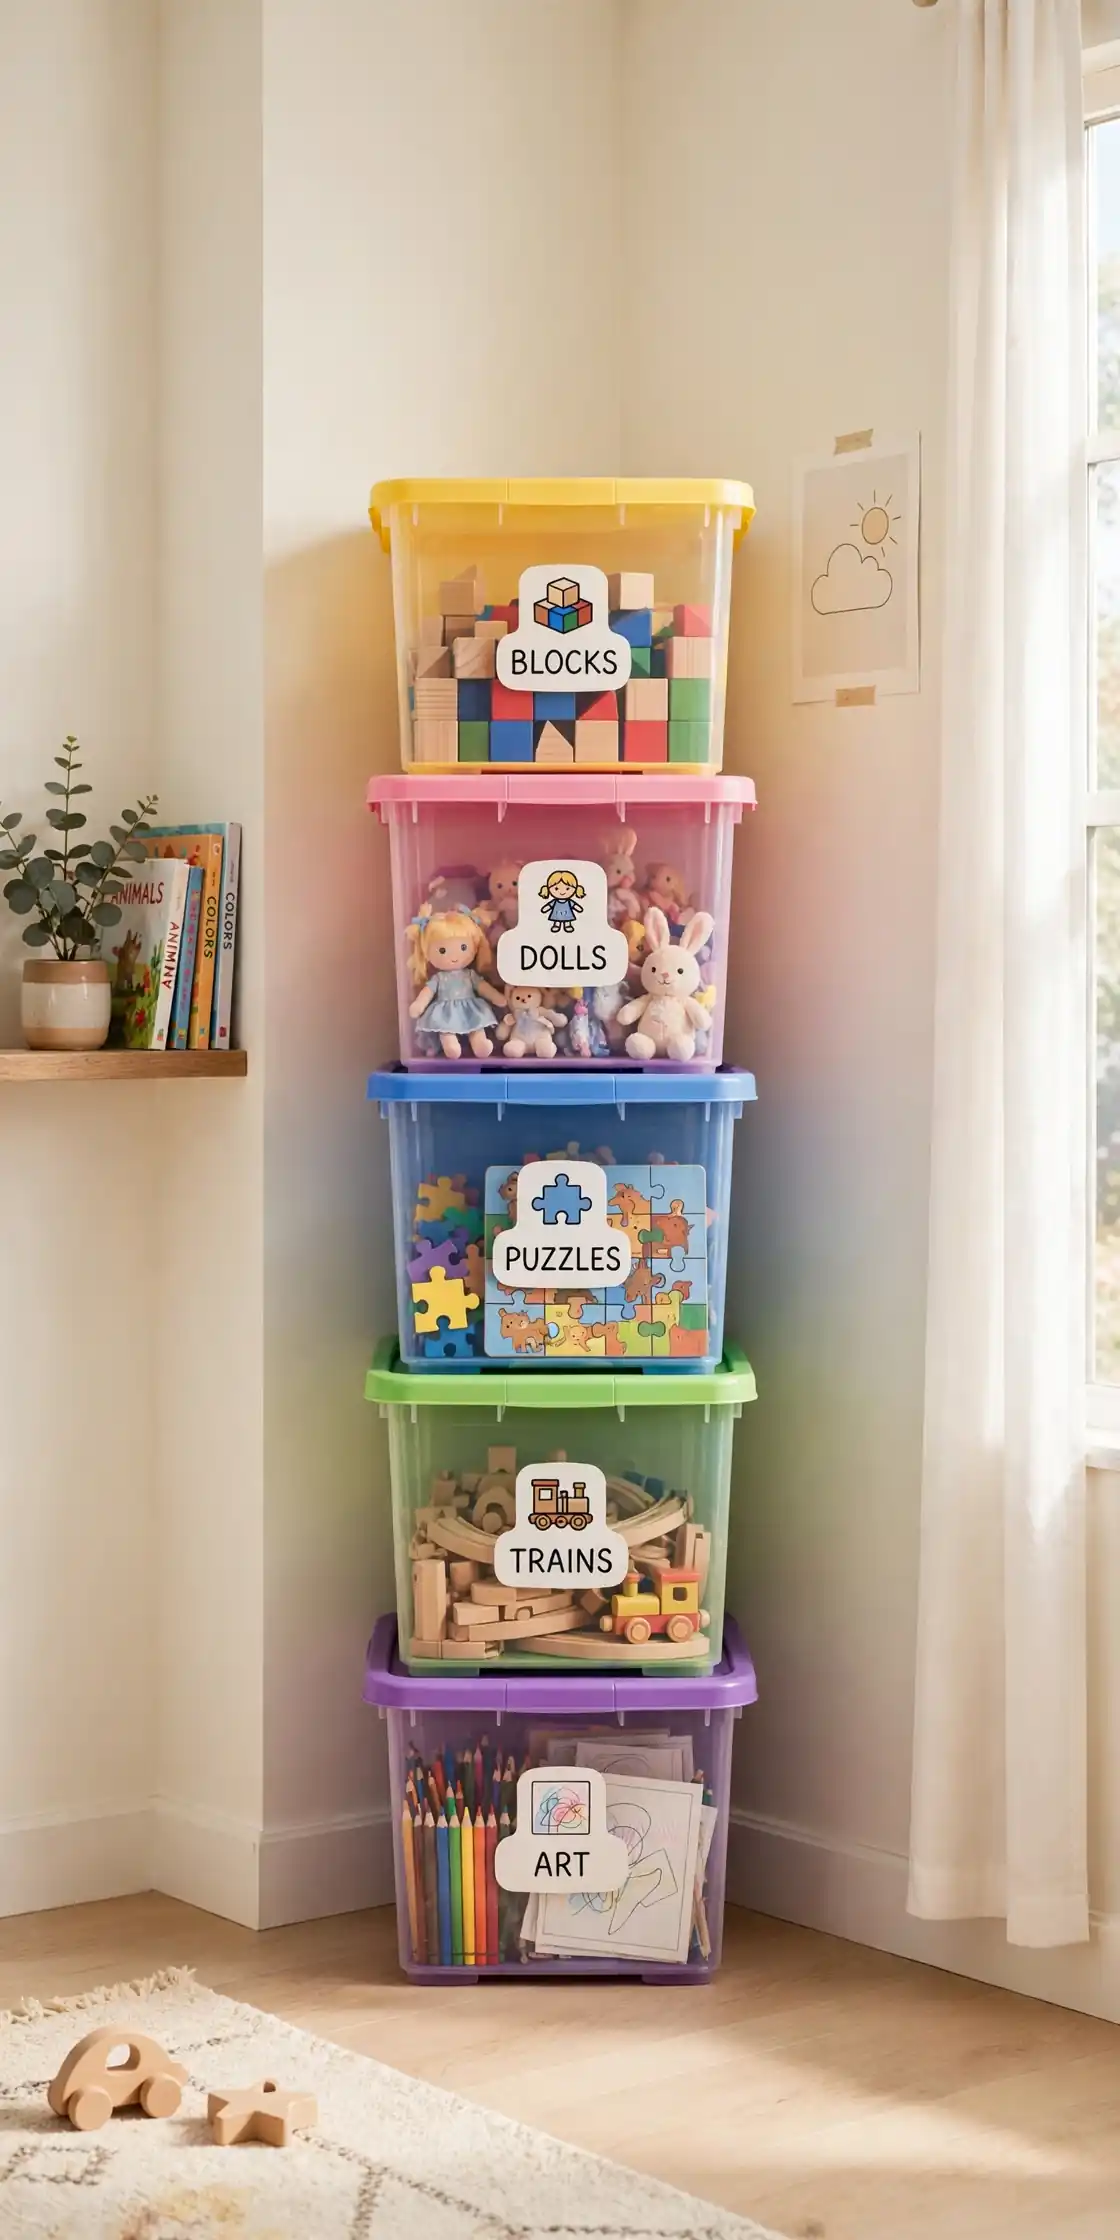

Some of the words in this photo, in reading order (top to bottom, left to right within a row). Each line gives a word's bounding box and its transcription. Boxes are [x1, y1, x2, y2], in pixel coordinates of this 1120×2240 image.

[511, 649, 618, 675] BLOCKS
[203, 896, 217, 959] COLORS
[223, 892, 235, 950] COLORS
[520, 944, 607, 971] DOLLS
[506, 1246, 621, 1272] PUZZLES
[509, 1547, 613, 1574] TRAINS
[534, 1851, 591, 1877] ART
